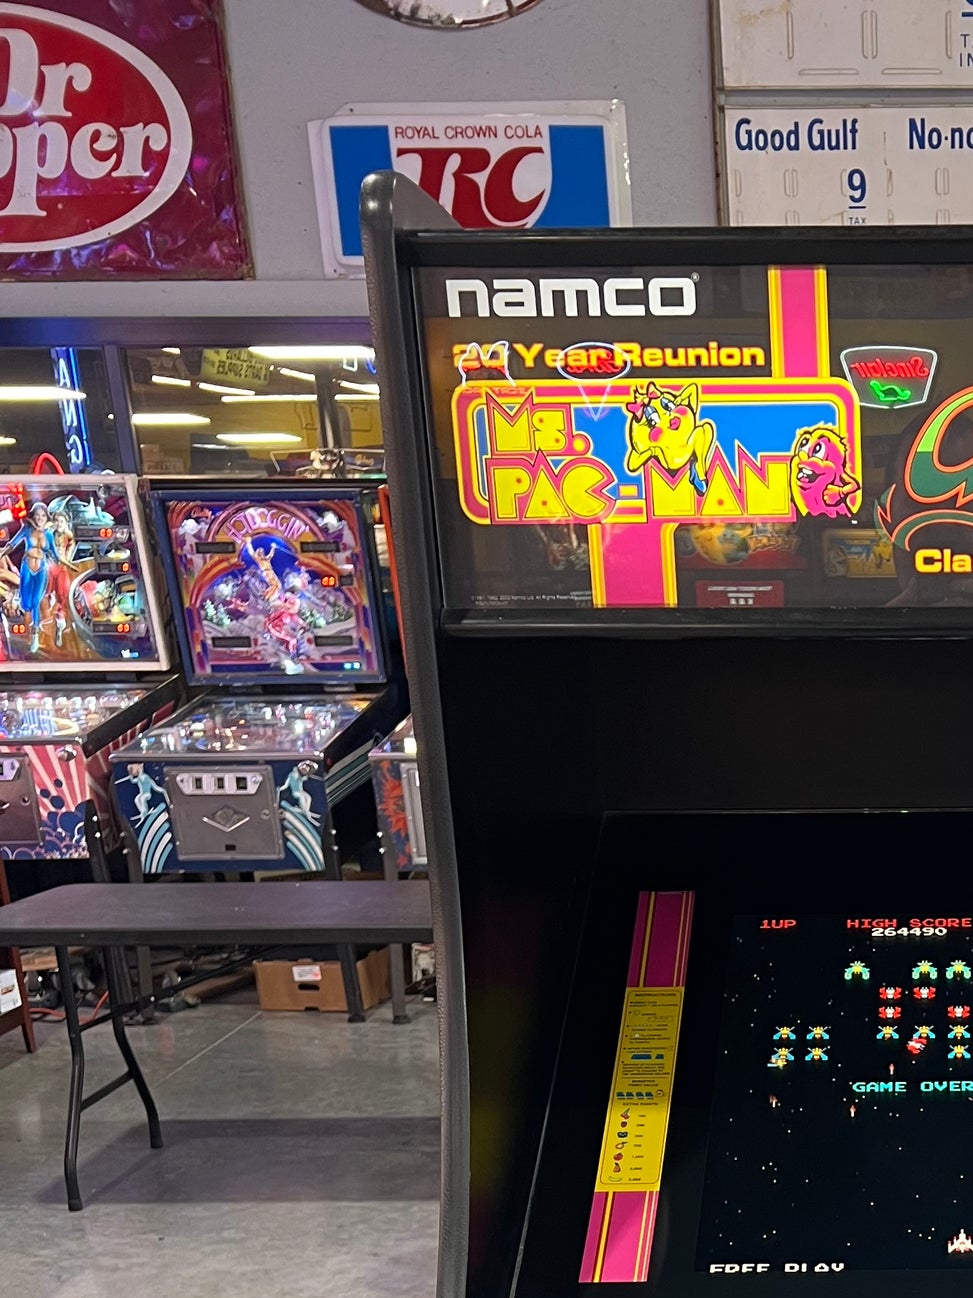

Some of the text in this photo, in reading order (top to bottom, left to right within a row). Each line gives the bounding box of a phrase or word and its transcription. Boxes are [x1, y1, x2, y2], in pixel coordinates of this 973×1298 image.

[394, 124, 543, 139] ROYAL CROWN COLA
[735, 118, 859, 151] Good Gulf
[847, 168, 867, 203] 9
[513, 342, 613, 368] Year
[613, 341, 766, 368] Reunion
[488, 448, 795, 522] PAC-MAN
[760, 917, 973, 929] 1UP HIGH SCORE
[871, 927, 948, 937] 264490
[852, 1081, 908, 1093] GAME
